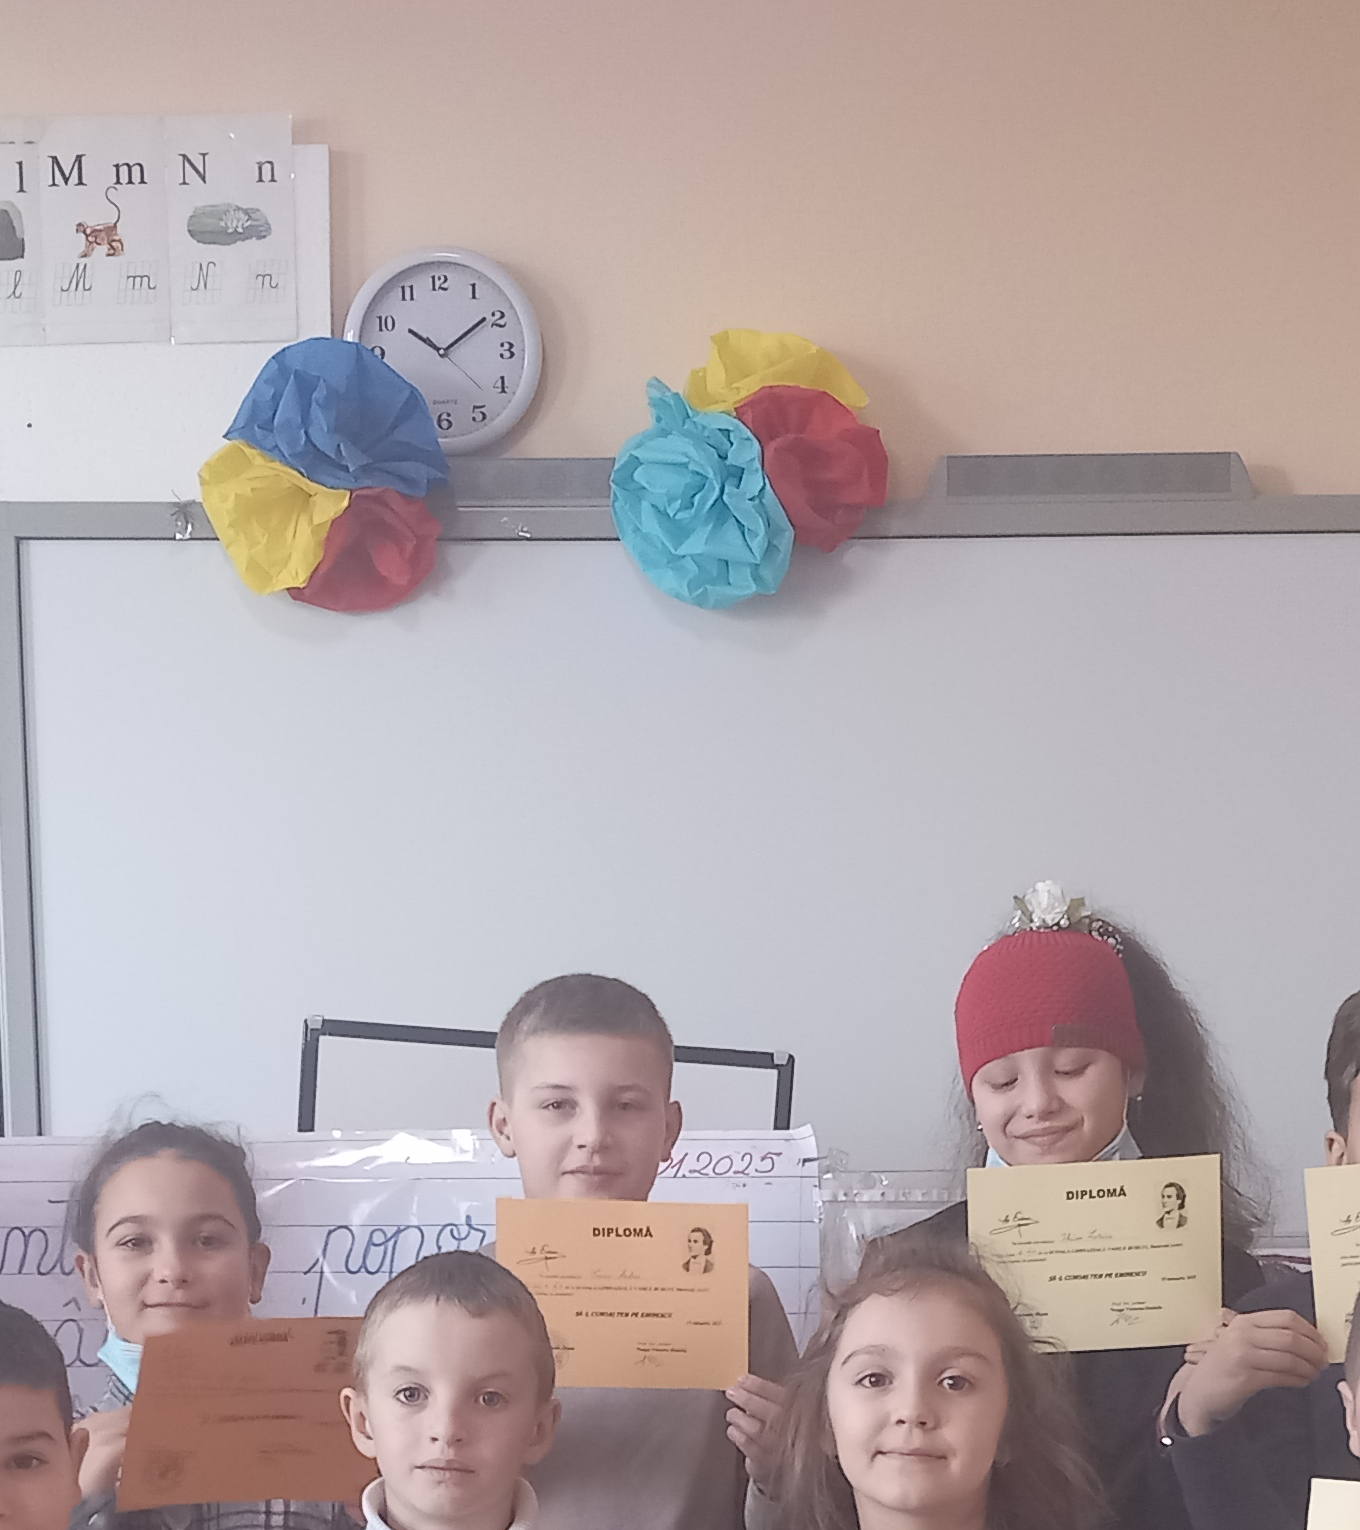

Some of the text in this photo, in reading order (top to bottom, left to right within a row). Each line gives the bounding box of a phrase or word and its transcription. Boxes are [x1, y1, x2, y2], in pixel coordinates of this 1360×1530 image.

[16, 161, 27, 193] l
[47, 154, 148, 186] M m
[178, 153, 277, 185] N n
[431, 275, 449, 291] 12
[469, 283, 479, 299] 1
[400, 284, 414, 301] 11
[376, 315, 395, 332] 10
[491, 310, 507, 328] 2
[500, 341, 515, 360] 3
[493, 376, 508, 394] 4
[437, 412, 453, 430] 6
[472, 405, 487, 423] 5
[1066, 1185, 1127, 1200] DIPLOMĂ
[592, 1226, 654, 1238] DIPLOMĂ
